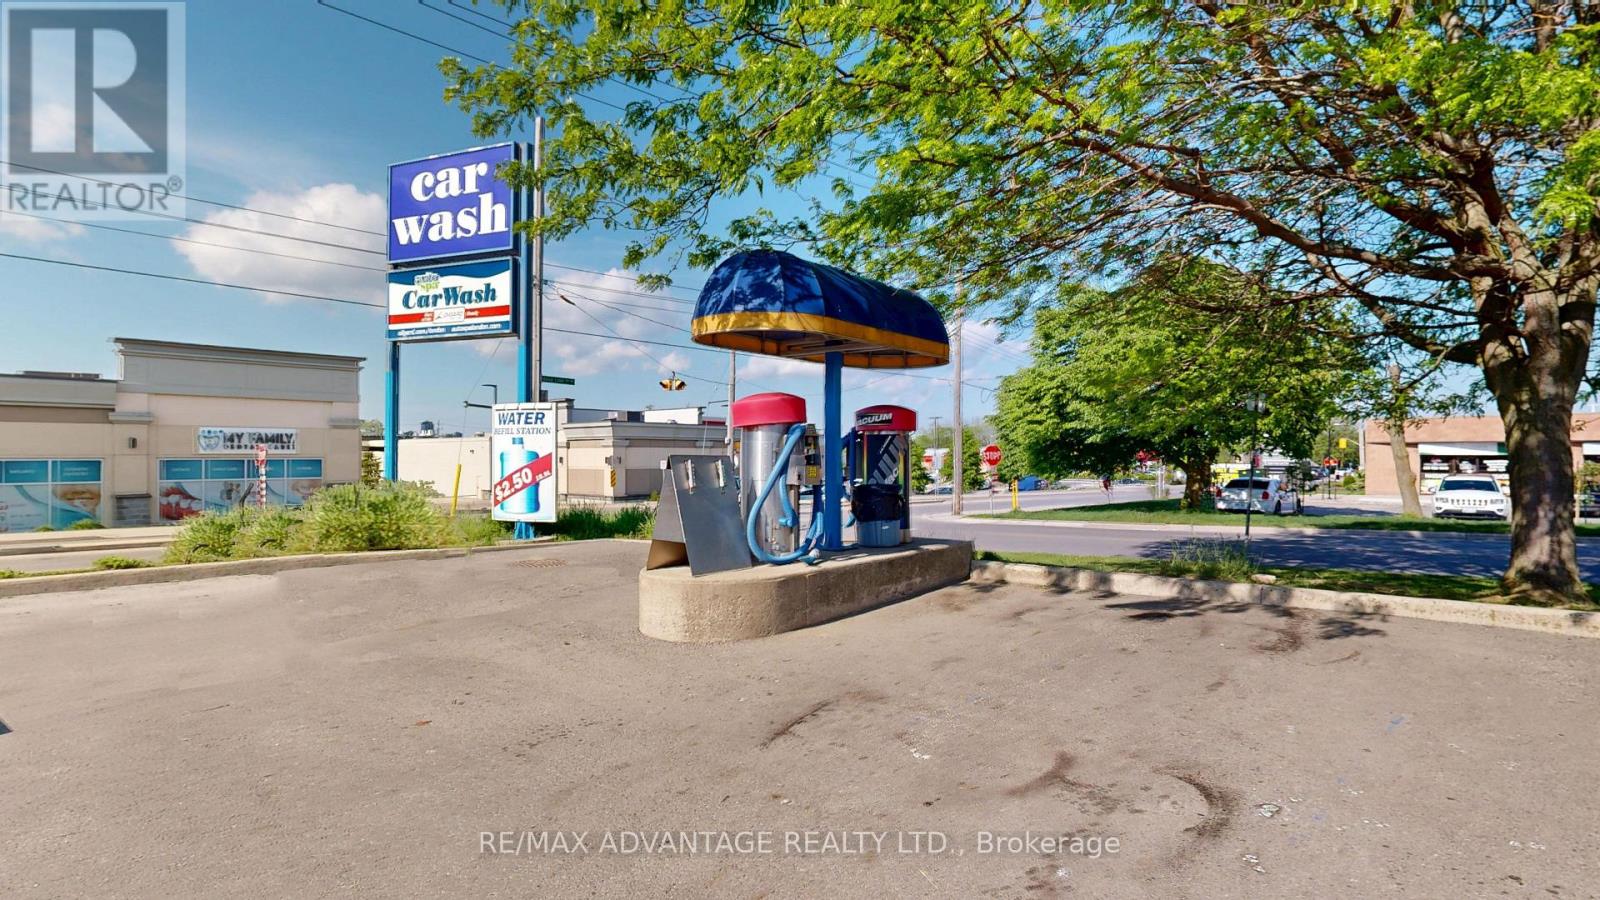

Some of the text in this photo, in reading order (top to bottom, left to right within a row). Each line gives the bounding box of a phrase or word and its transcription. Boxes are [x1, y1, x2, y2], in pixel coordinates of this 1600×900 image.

[410, 161, 489, 202] car
[392, 192, 509, 246] wash
[498, 411, 546, 426] WATER
[515, 426, 552, 435] STATION
[495, 467, 533, 502] $2.50
